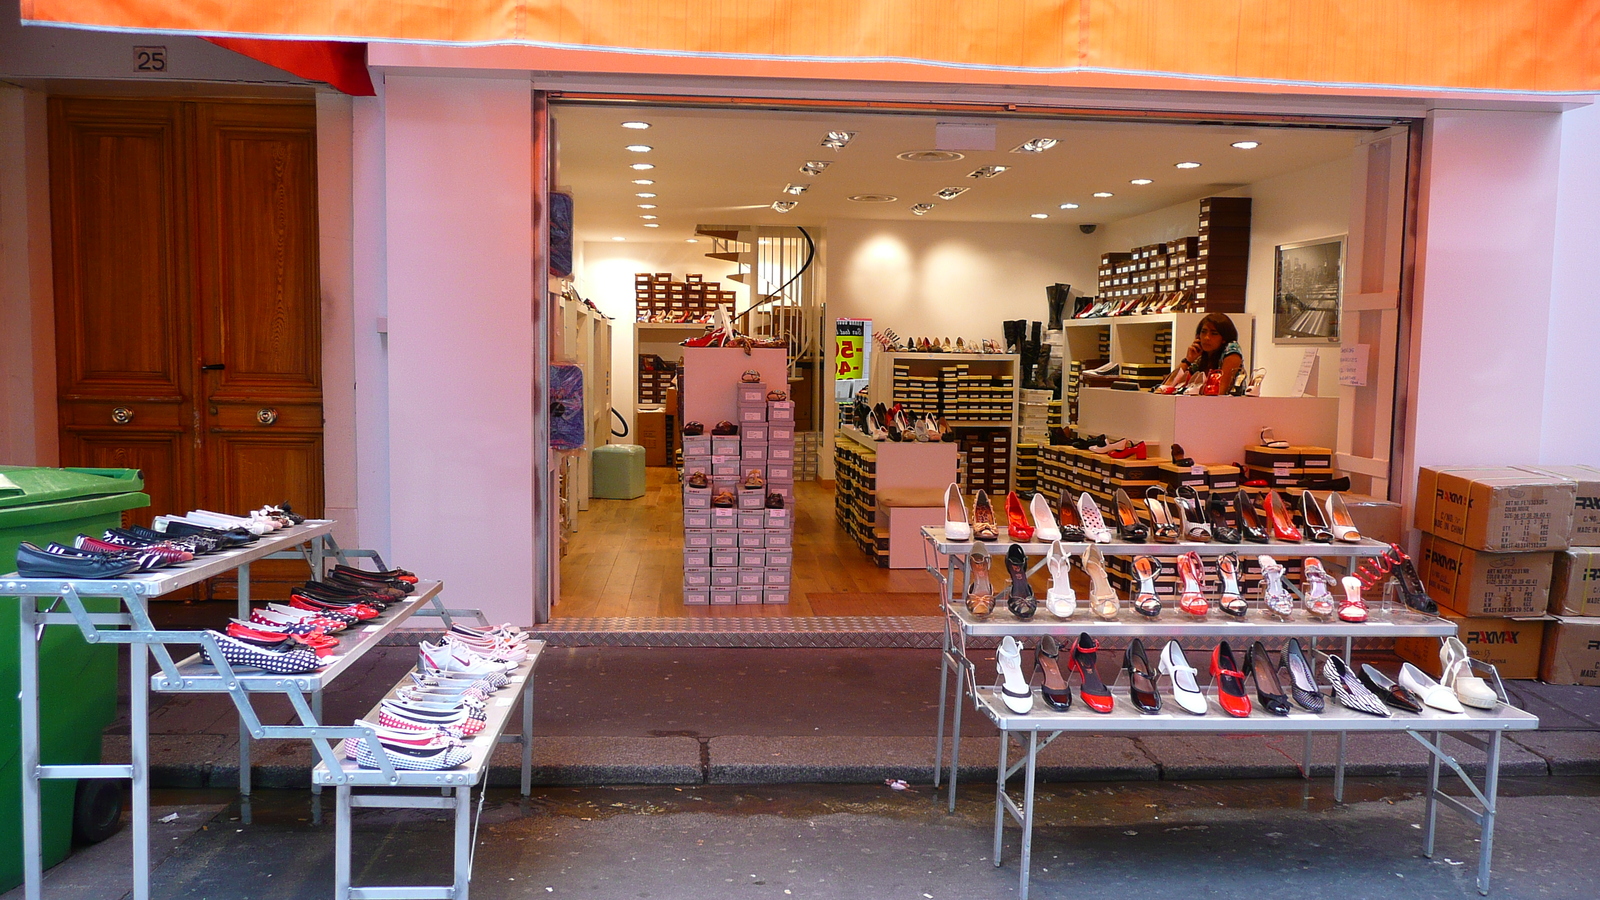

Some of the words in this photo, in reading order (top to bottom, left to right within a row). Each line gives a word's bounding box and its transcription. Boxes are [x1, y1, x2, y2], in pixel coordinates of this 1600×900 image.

[138, 52, 164, 70] 25
[1467, 630, 1520, 644] RAXMAX
[1580, 669, 1597, 678] MADE
